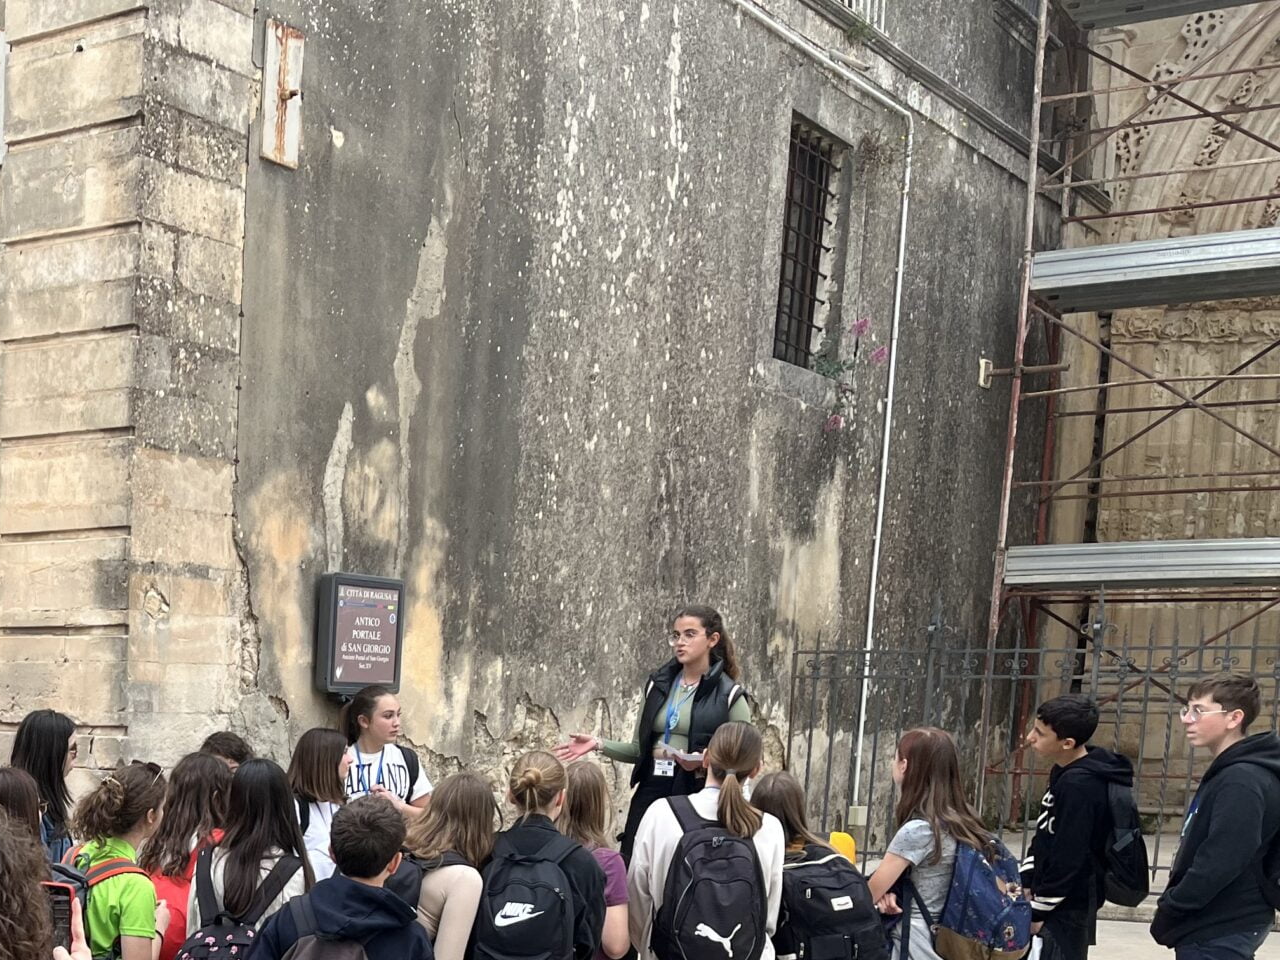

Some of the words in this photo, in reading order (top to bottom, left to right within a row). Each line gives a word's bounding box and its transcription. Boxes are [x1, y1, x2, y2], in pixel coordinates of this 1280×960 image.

[370, 591, 392, 600] RAGUSA
[354, 616, 381, 627] ANTICO
[352, 629, 382, 641] PORTALE
[341, 643, 347, 652] di
[348, 643, 362, 653] SAN
[362, 644, 391, 655] GIORGIO
[501, 902, 535, 917] NIKE
